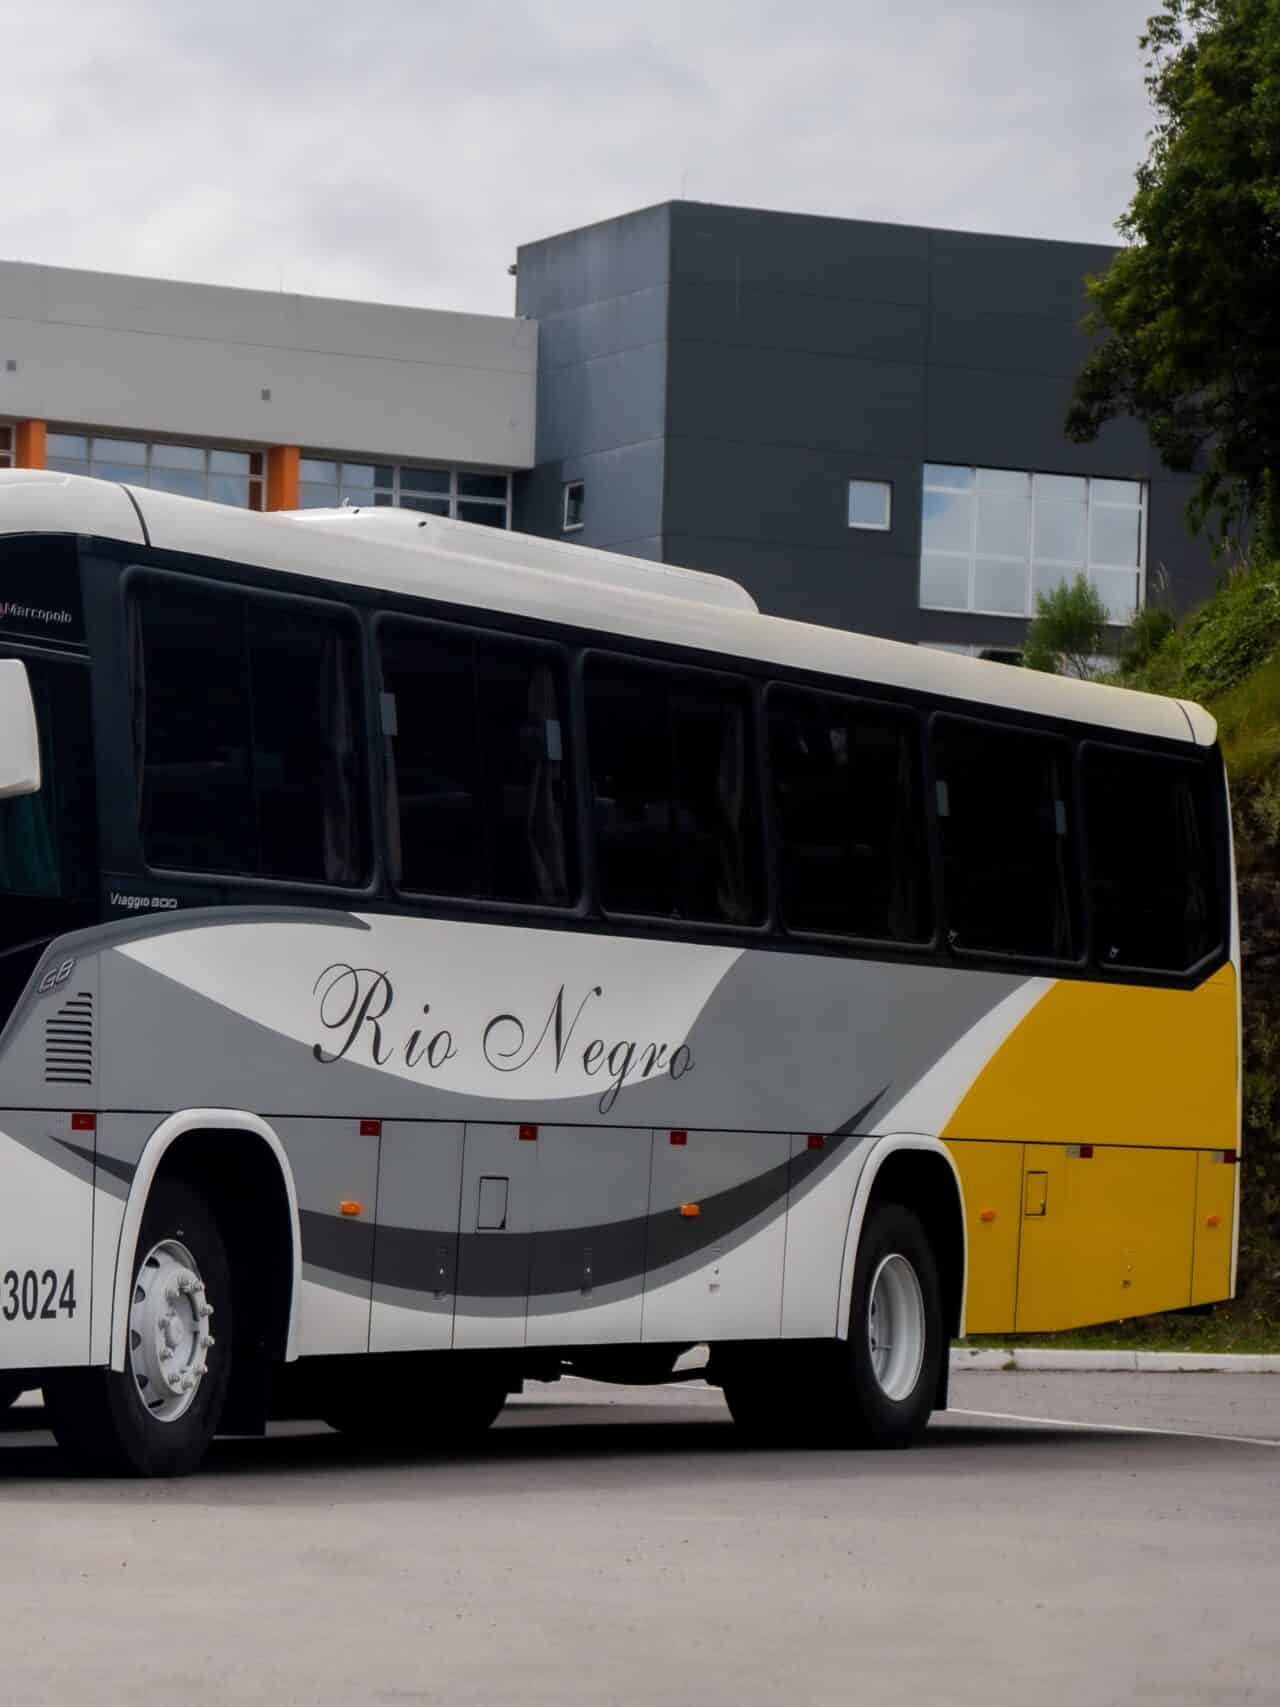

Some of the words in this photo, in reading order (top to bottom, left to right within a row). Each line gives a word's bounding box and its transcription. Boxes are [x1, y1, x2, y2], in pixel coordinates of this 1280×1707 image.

[4, 601, 72, 623] Marcopolo
[110, 892, 149, 909] Viaggio
[151, 897, 177, 909] 800
[312, 963, 458, 1068] Rio
[482, 983, 696, 1115] Negro
